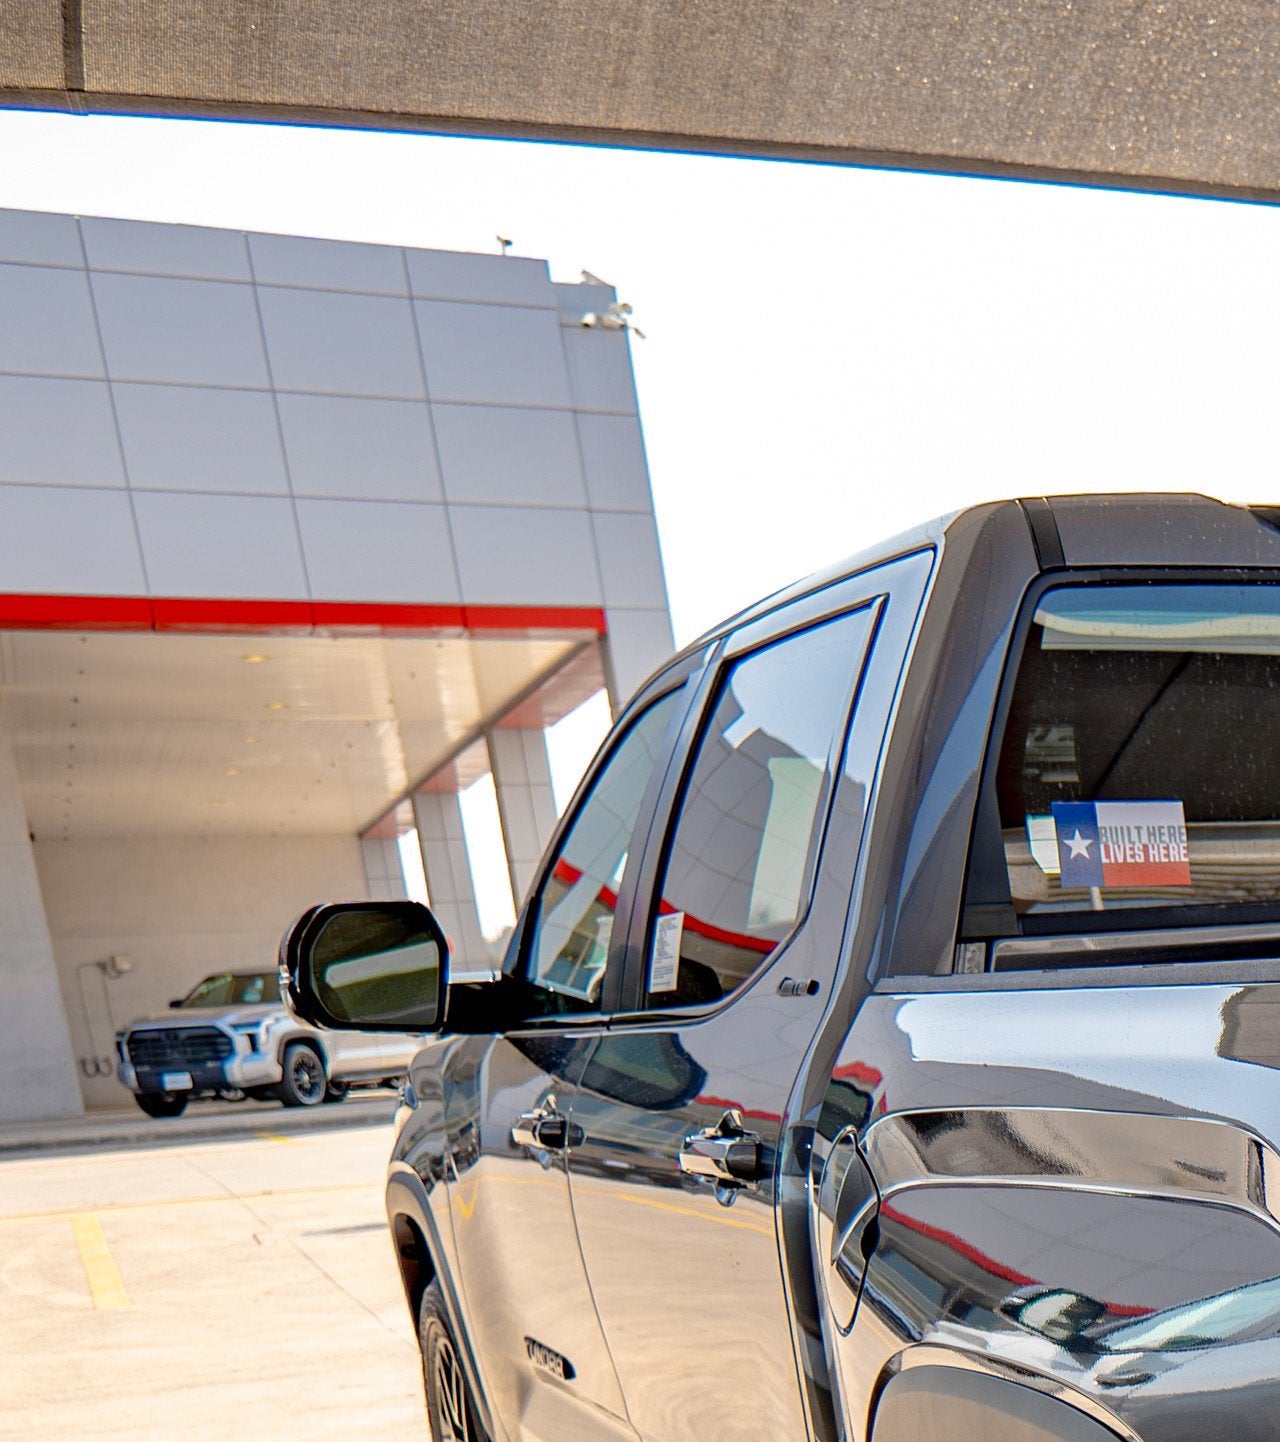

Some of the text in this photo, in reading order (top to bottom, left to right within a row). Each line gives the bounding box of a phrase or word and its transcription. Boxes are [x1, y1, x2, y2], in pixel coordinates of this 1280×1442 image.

[1100, 825, 1187, 845] BUILT HERE
[1101, 844, 1189, 863] LIVES HERE
